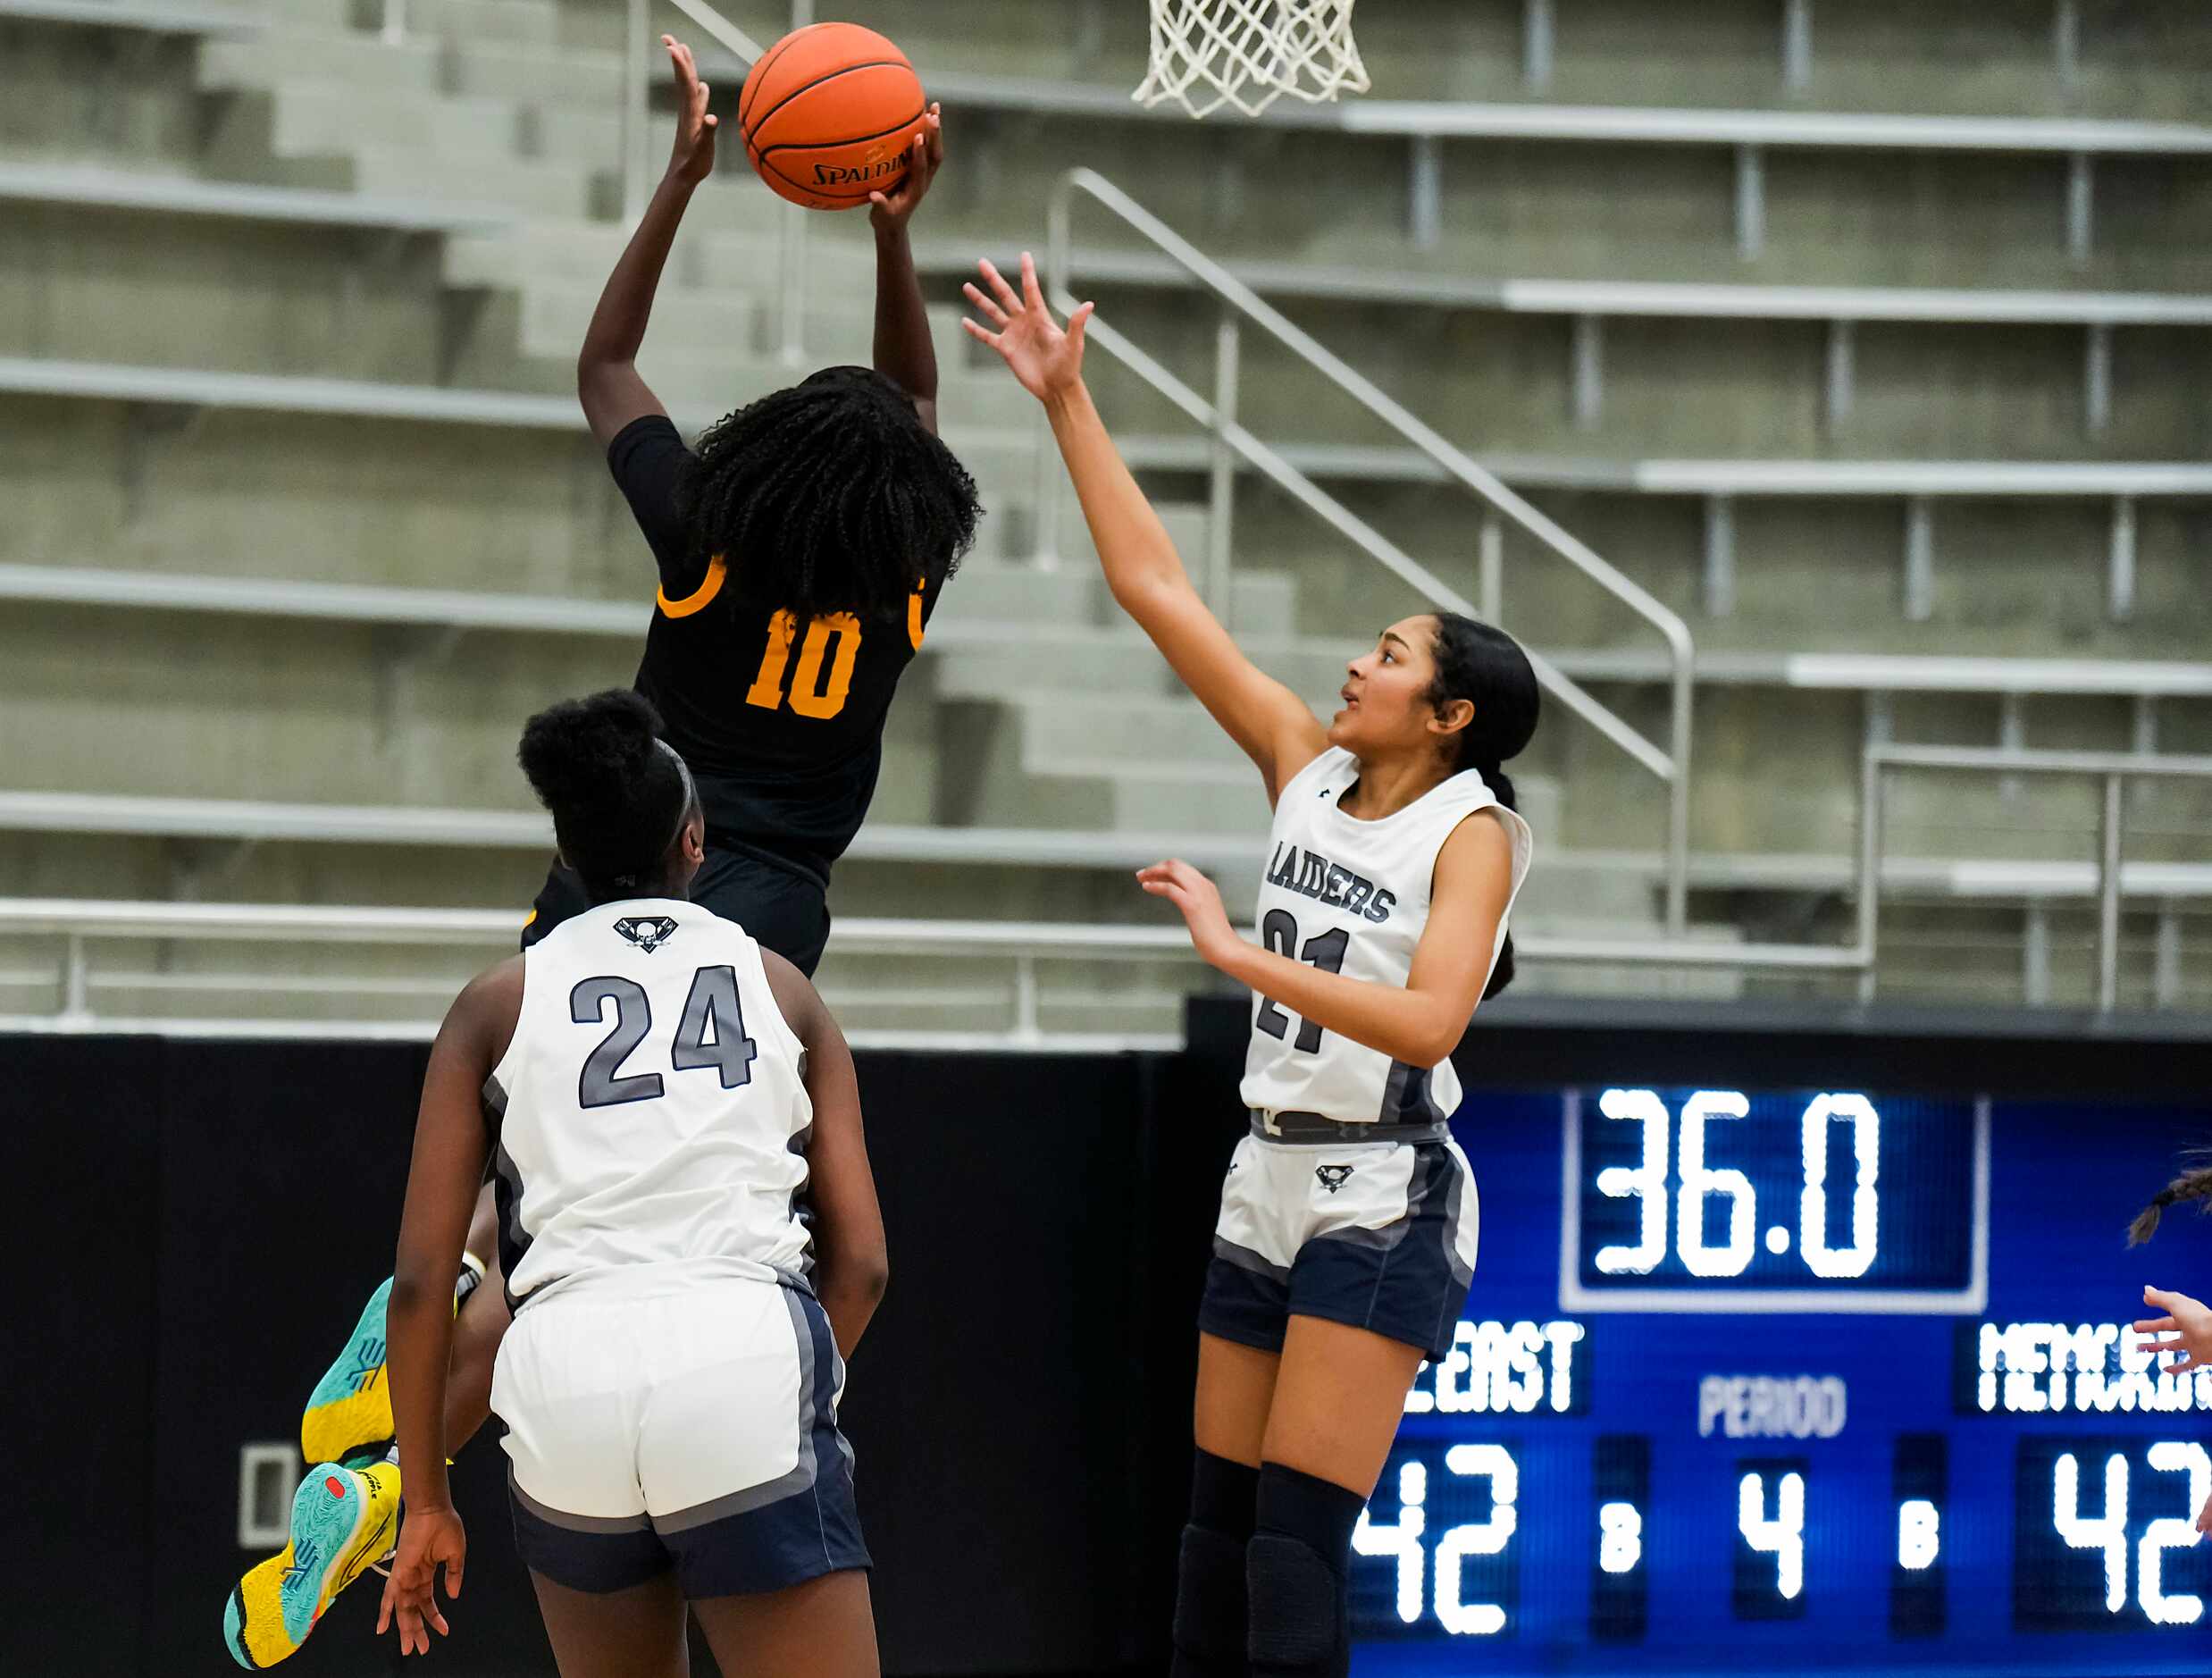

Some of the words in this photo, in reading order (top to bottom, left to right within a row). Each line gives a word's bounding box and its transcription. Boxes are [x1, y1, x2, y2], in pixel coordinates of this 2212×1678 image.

[812, 152, 913, 186] SPALDIN
[745, 606, 862, 720] 10
[569, 964, 758, 1109] 24
[1256, 908, 1350, 1055] 21
[1596, 1090, 1880, 1278] 36.0
[1698, 1374, 1848, 1439] PERIOD
[1351, 1444, 1518, 1635] 42
[1739, 1472, 1805, 1599] 4
[2054, 1441, 2212, 1625] 42
